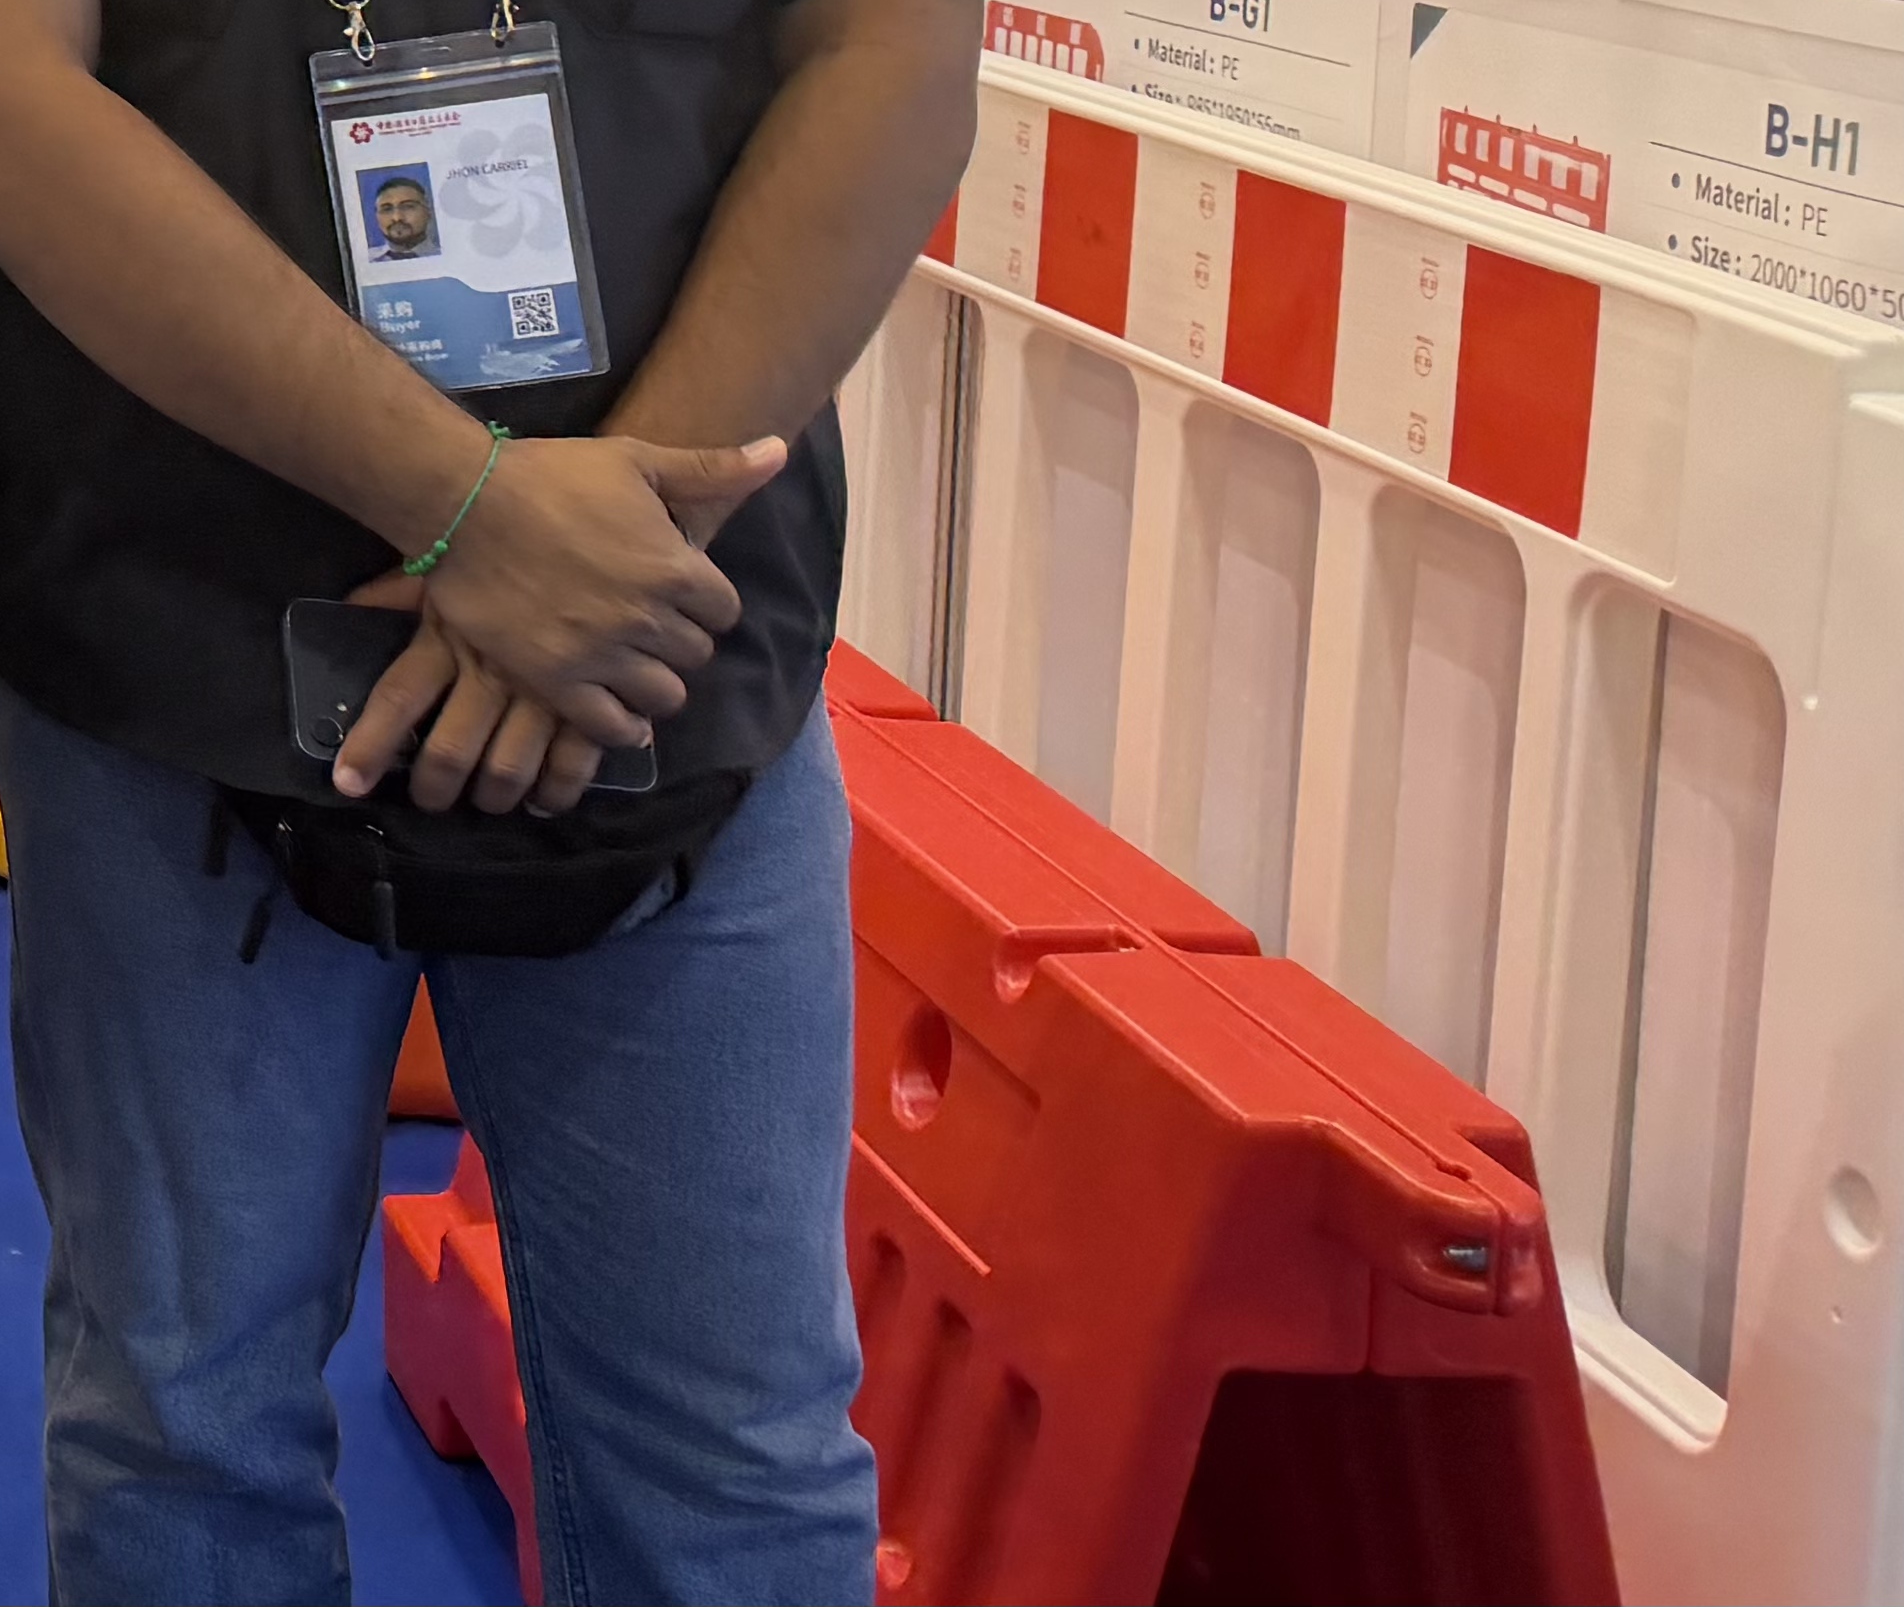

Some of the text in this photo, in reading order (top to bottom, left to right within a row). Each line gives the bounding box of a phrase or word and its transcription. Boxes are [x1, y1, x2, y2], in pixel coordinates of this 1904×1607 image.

[1221, 54, 1240, 81] PE
[1765, 103, 1860, 176] B-H1
[1802, 203, 1828, 237] PE
